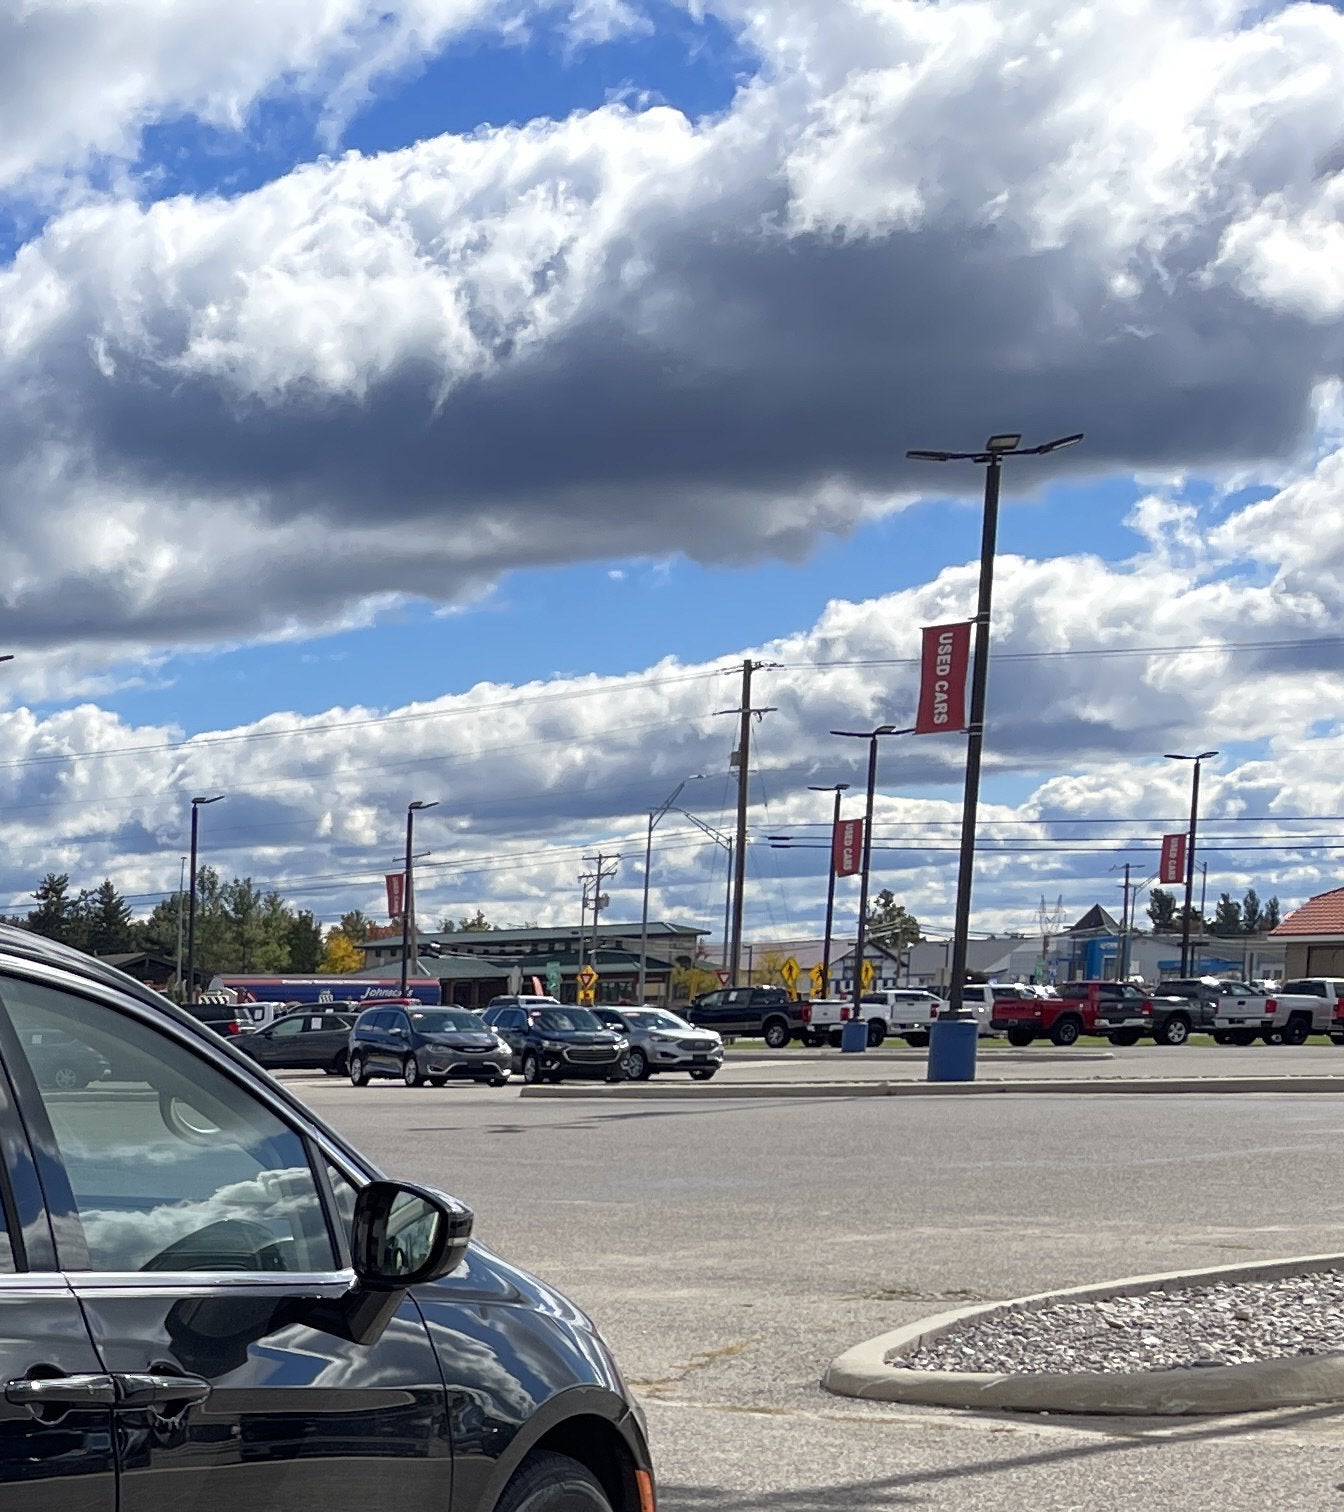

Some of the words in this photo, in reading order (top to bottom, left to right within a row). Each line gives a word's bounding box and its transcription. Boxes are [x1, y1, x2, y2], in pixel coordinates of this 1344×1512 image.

[935, 632, 954, 676] USED
[933, 680, 949, 725] CARS
[843, 823, 854, 847] USED
[842, 847, 853, 871] CARS
[1167, 860, 1177, 881] CARS
[360, 986, 413, 999] Johnso's
